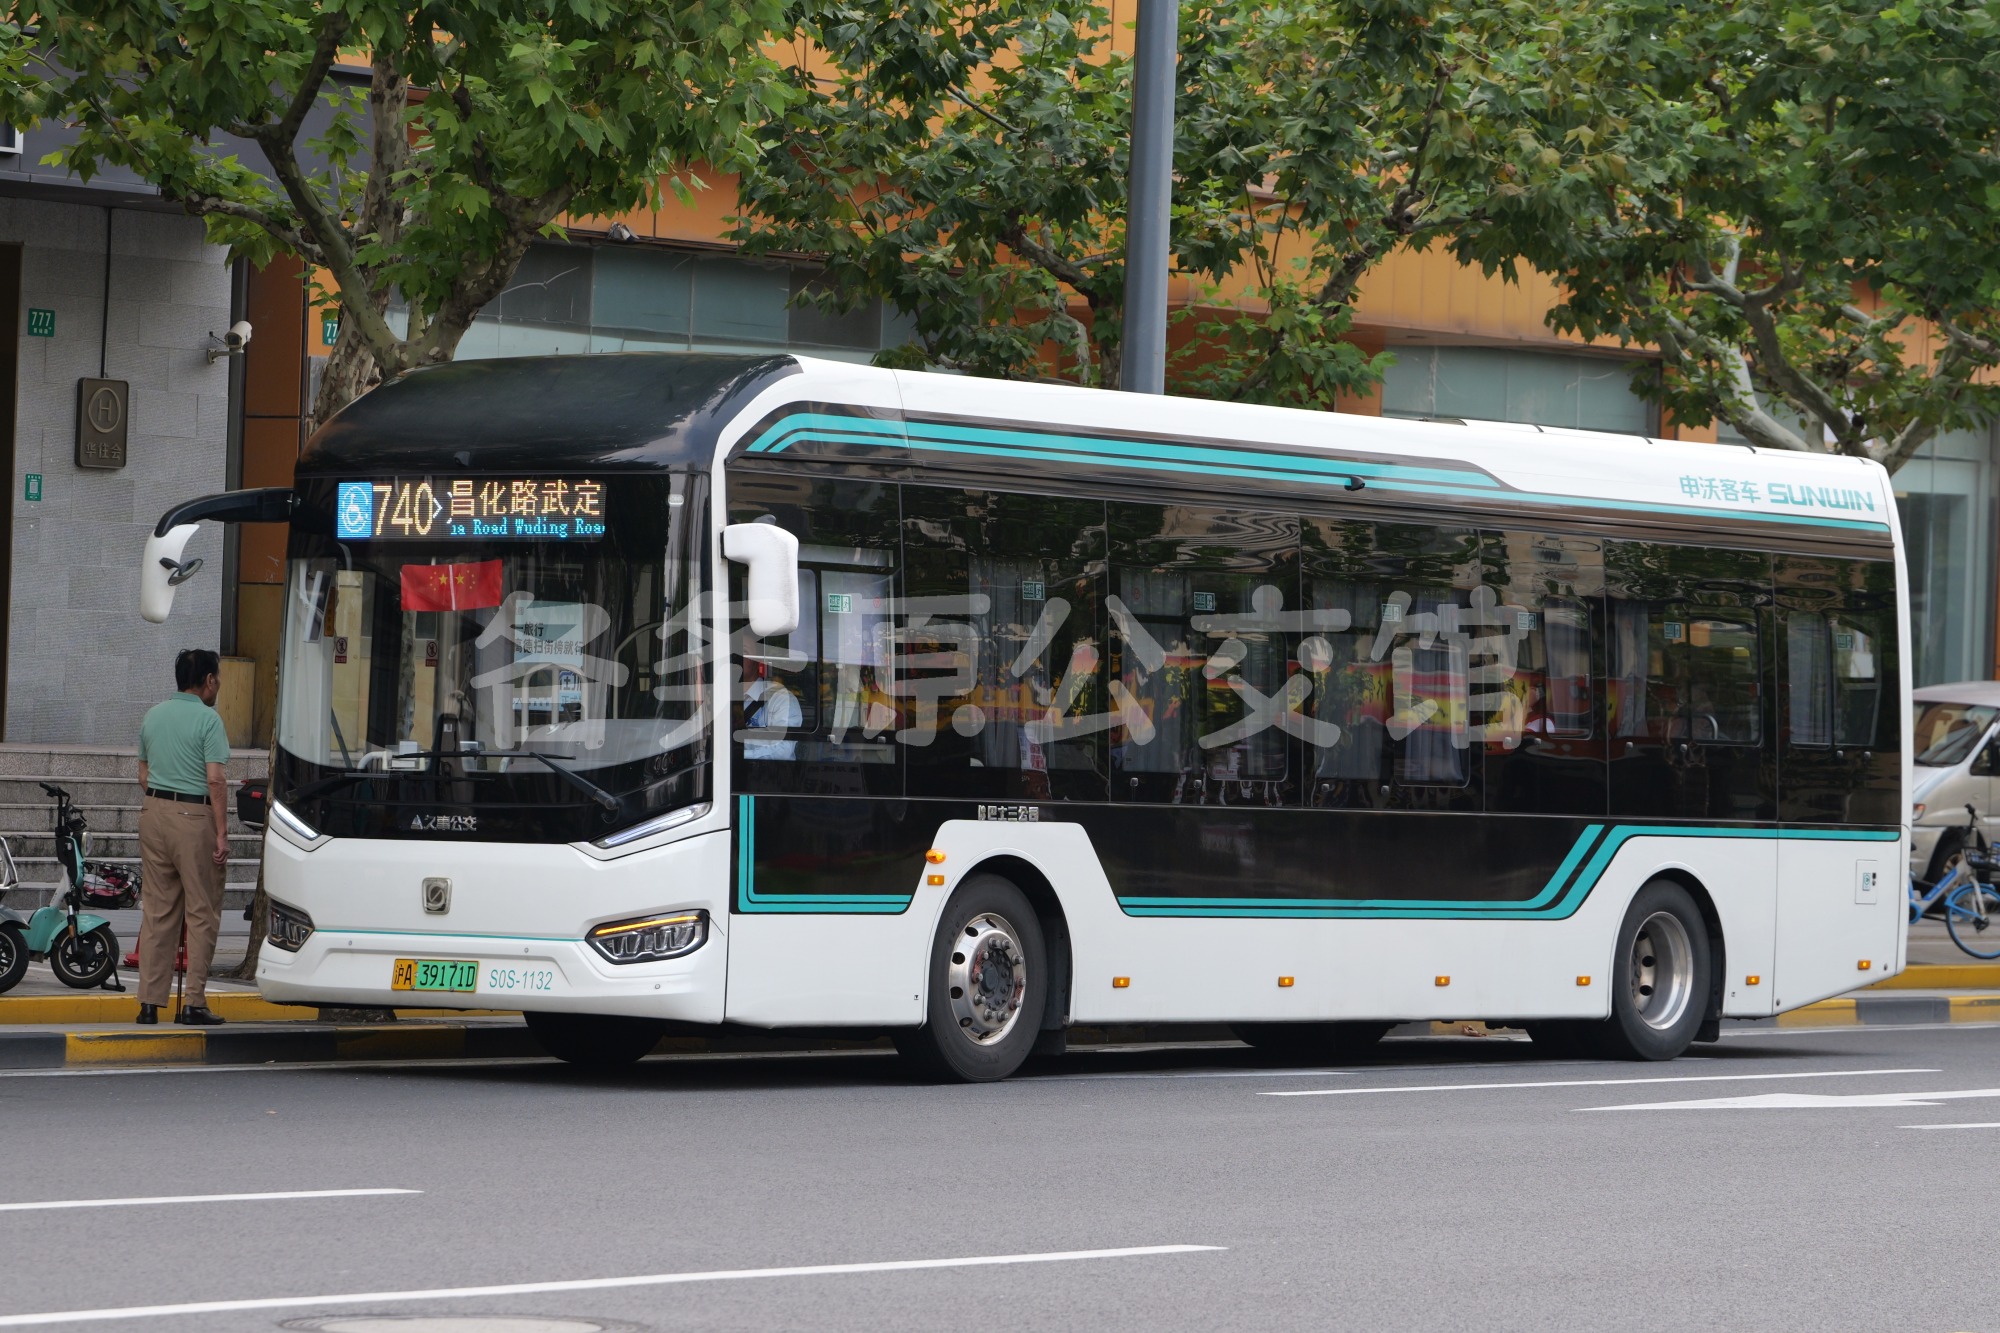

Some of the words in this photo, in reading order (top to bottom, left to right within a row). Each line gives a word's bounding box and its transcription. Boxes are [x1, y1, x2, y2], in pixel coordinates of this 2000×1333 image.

[32, 311, 51, 327] 777
[85, 442, 122, 461] 华住会
[450, 479, 601, 516] 昌化路武定
[1679, 475, 1761, 504] 申沃客车
[1767, 482, 1875, 513] SUNWIN
[372, 482, 433, 536] 740
[473, 517, 508, 536] Road
[515, 517, 568, 538] Wuding
[394, 963, 413, 987] 沪A
[419, 963, 476, 987] 39171D
